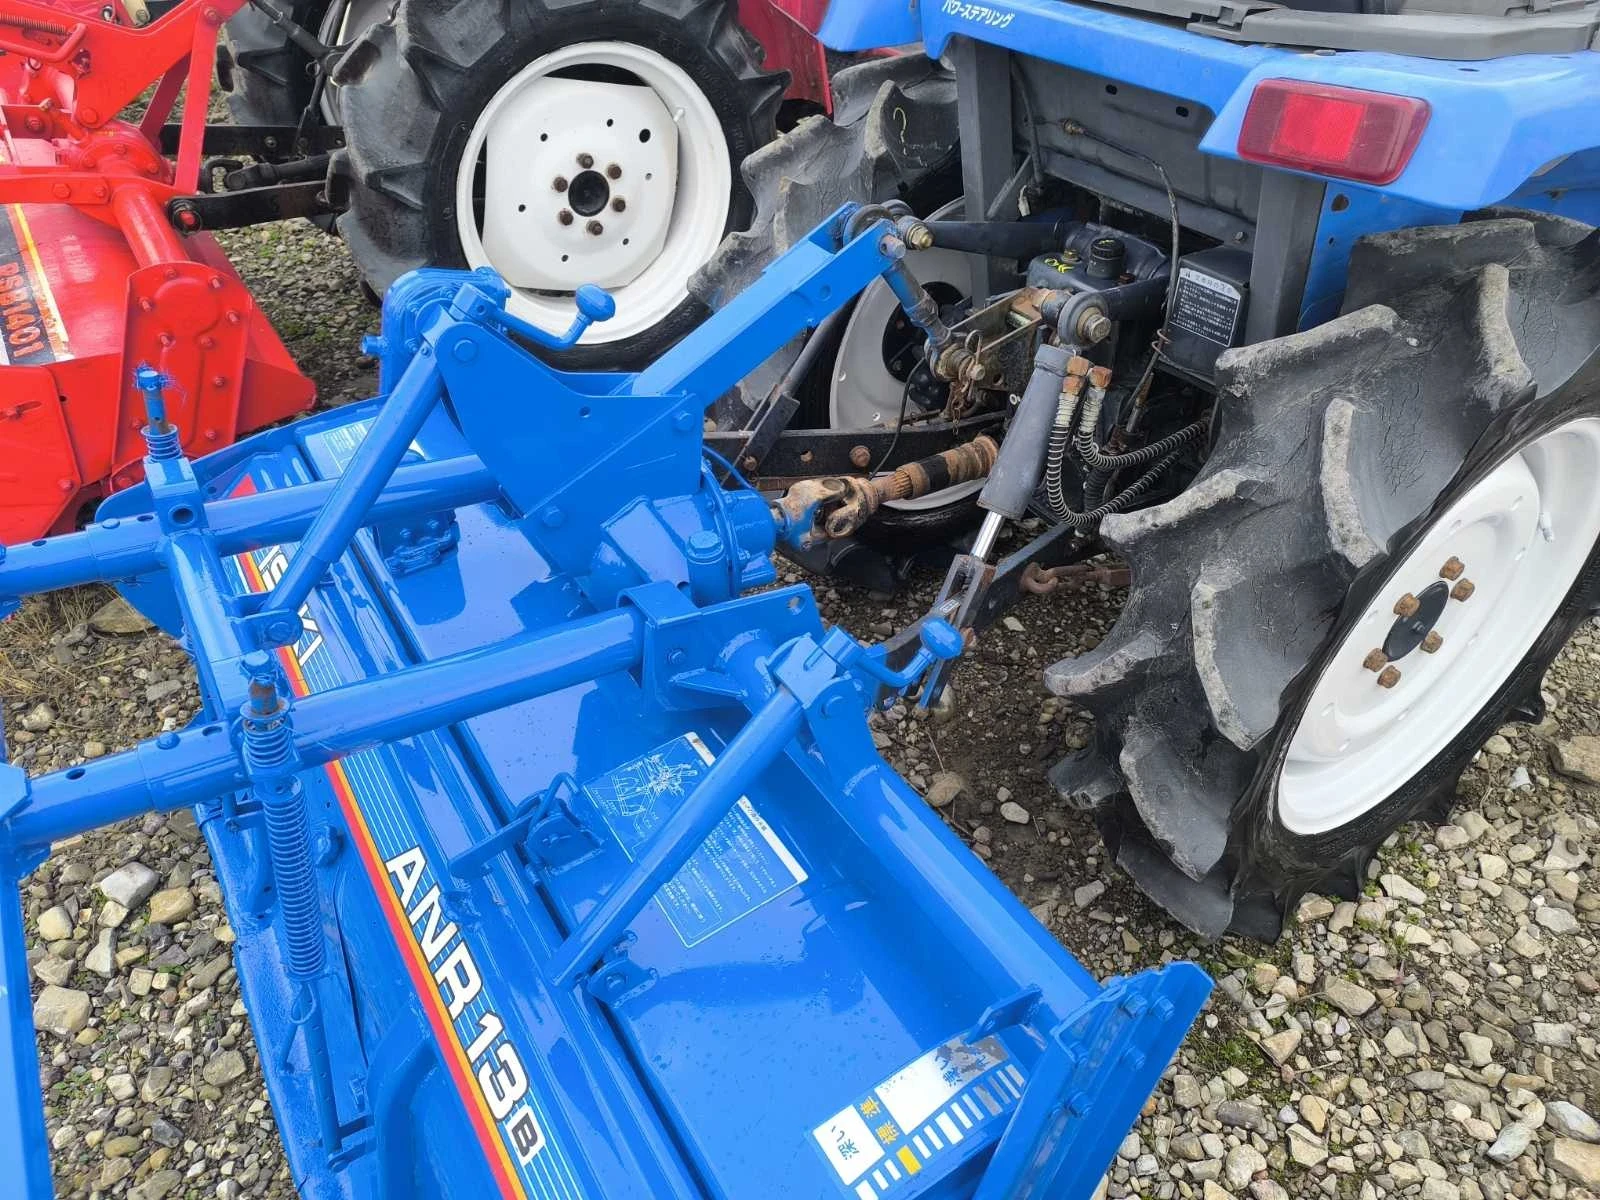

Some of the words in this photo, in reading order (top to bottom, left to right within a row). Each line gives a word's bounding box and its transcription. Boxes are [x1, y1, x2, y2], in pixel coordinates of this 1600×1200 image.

[942, 0, 1016, 28] パワーステアリング
[257, 544, 325, 668] ISKI
[830, 1125, 860, 1161] 深い
